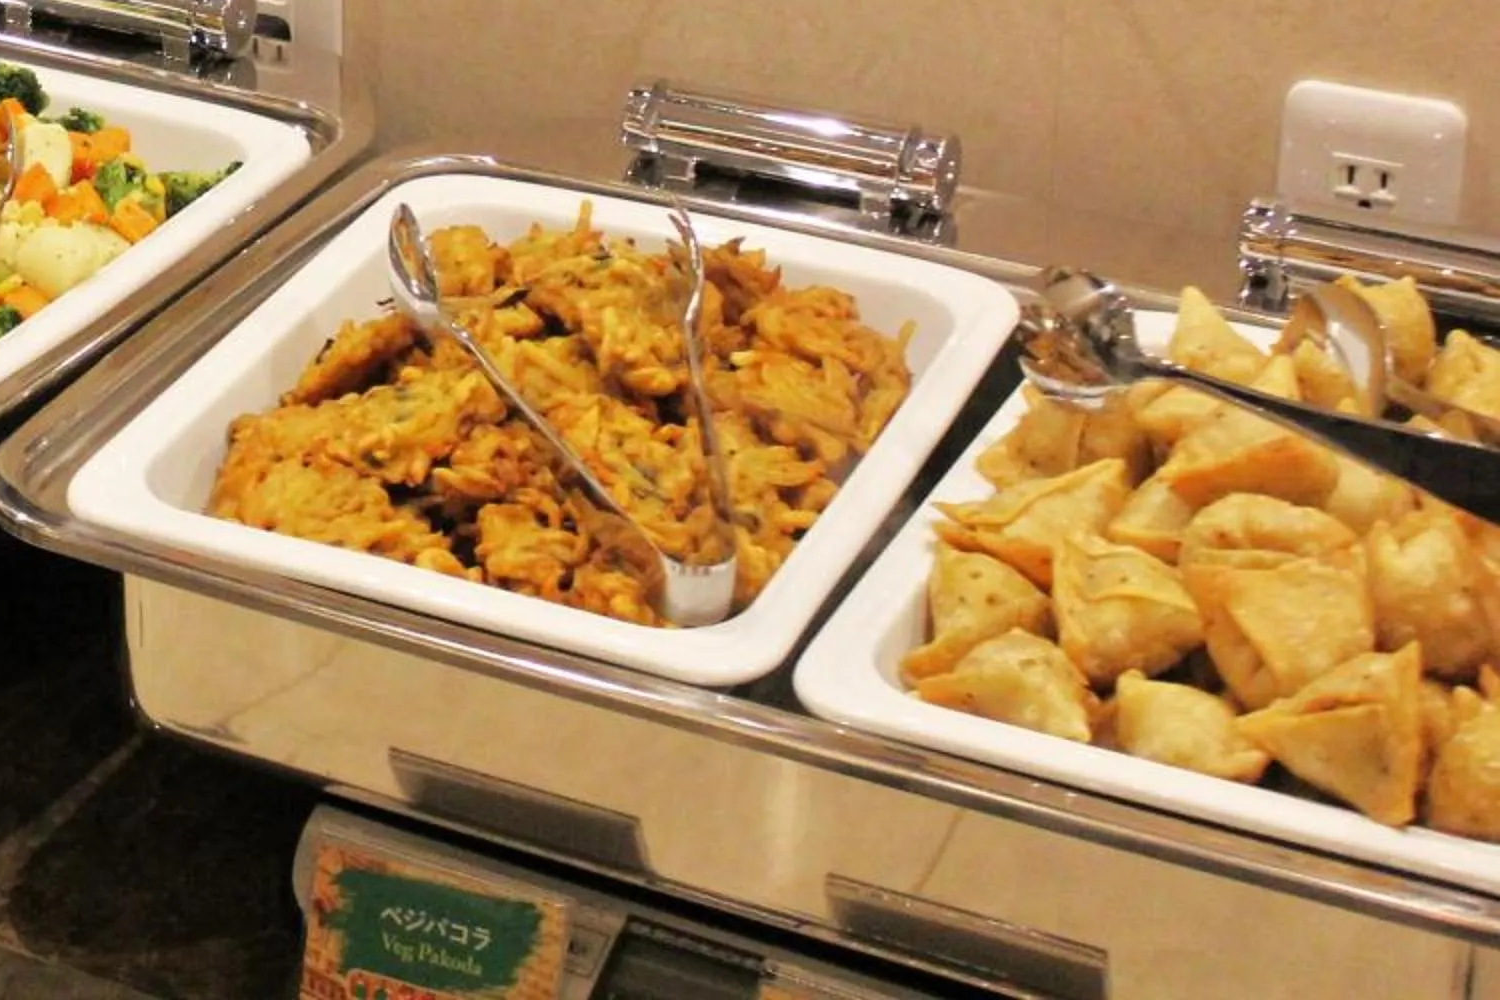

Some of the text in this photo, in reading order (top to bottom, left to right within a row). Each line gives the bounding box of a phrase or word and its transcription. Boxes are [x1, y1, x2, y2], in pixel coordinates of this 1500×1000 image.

[380, 906, 492, 951] ベジパコラ
[381, 932, 414, 963] Veg
